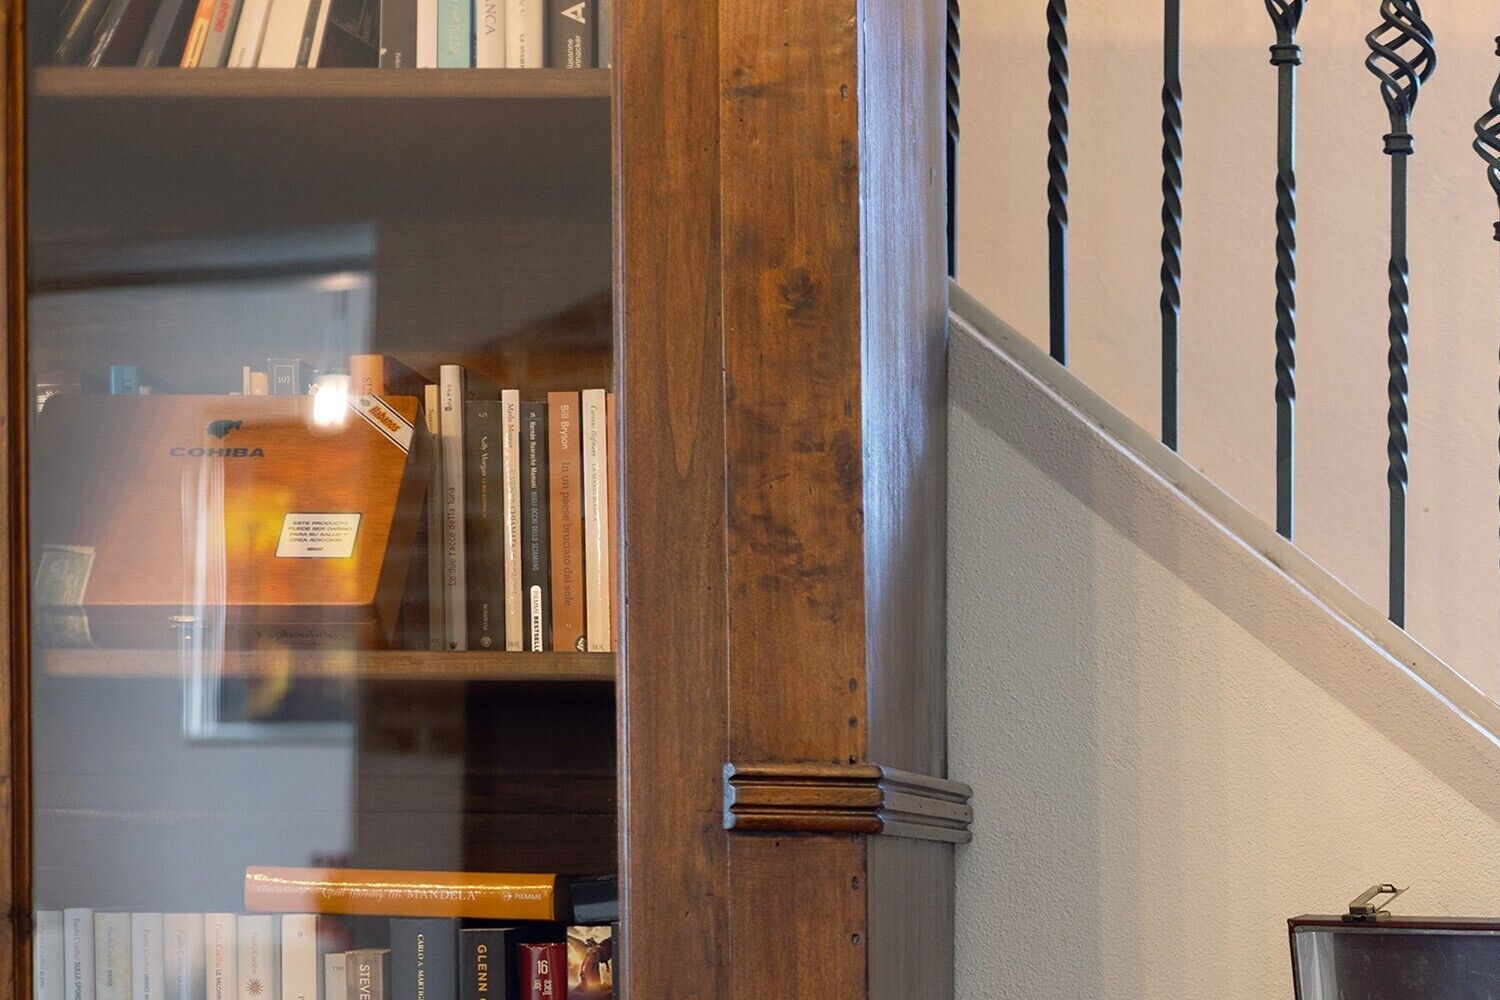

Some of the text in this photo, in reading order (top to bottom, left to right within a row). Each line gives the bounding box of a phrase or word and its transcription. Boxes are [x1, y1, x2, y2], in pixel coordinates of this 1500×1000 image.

[368, 405, 402, 433] Habanos
[560, 405, 569, 419] Bill
[558, 421, 569, 450] Bryson
[169, 447, 265, 458] COHIBA
[561, 463, 570, 473] In
[561, 476, 570, 490] un
[558, 491, 570, 520] paese
[448, 559, 457, 573] due
[564, 585, 573, 606] sole
[407, 891, 476, 901] MANDELA
[514, 893, 542, 901] PIEMME
[74, 962, 82, 980] SULLA
[476, 944, 488, 992] GLENN
[536, 960, 549, 974] 16
